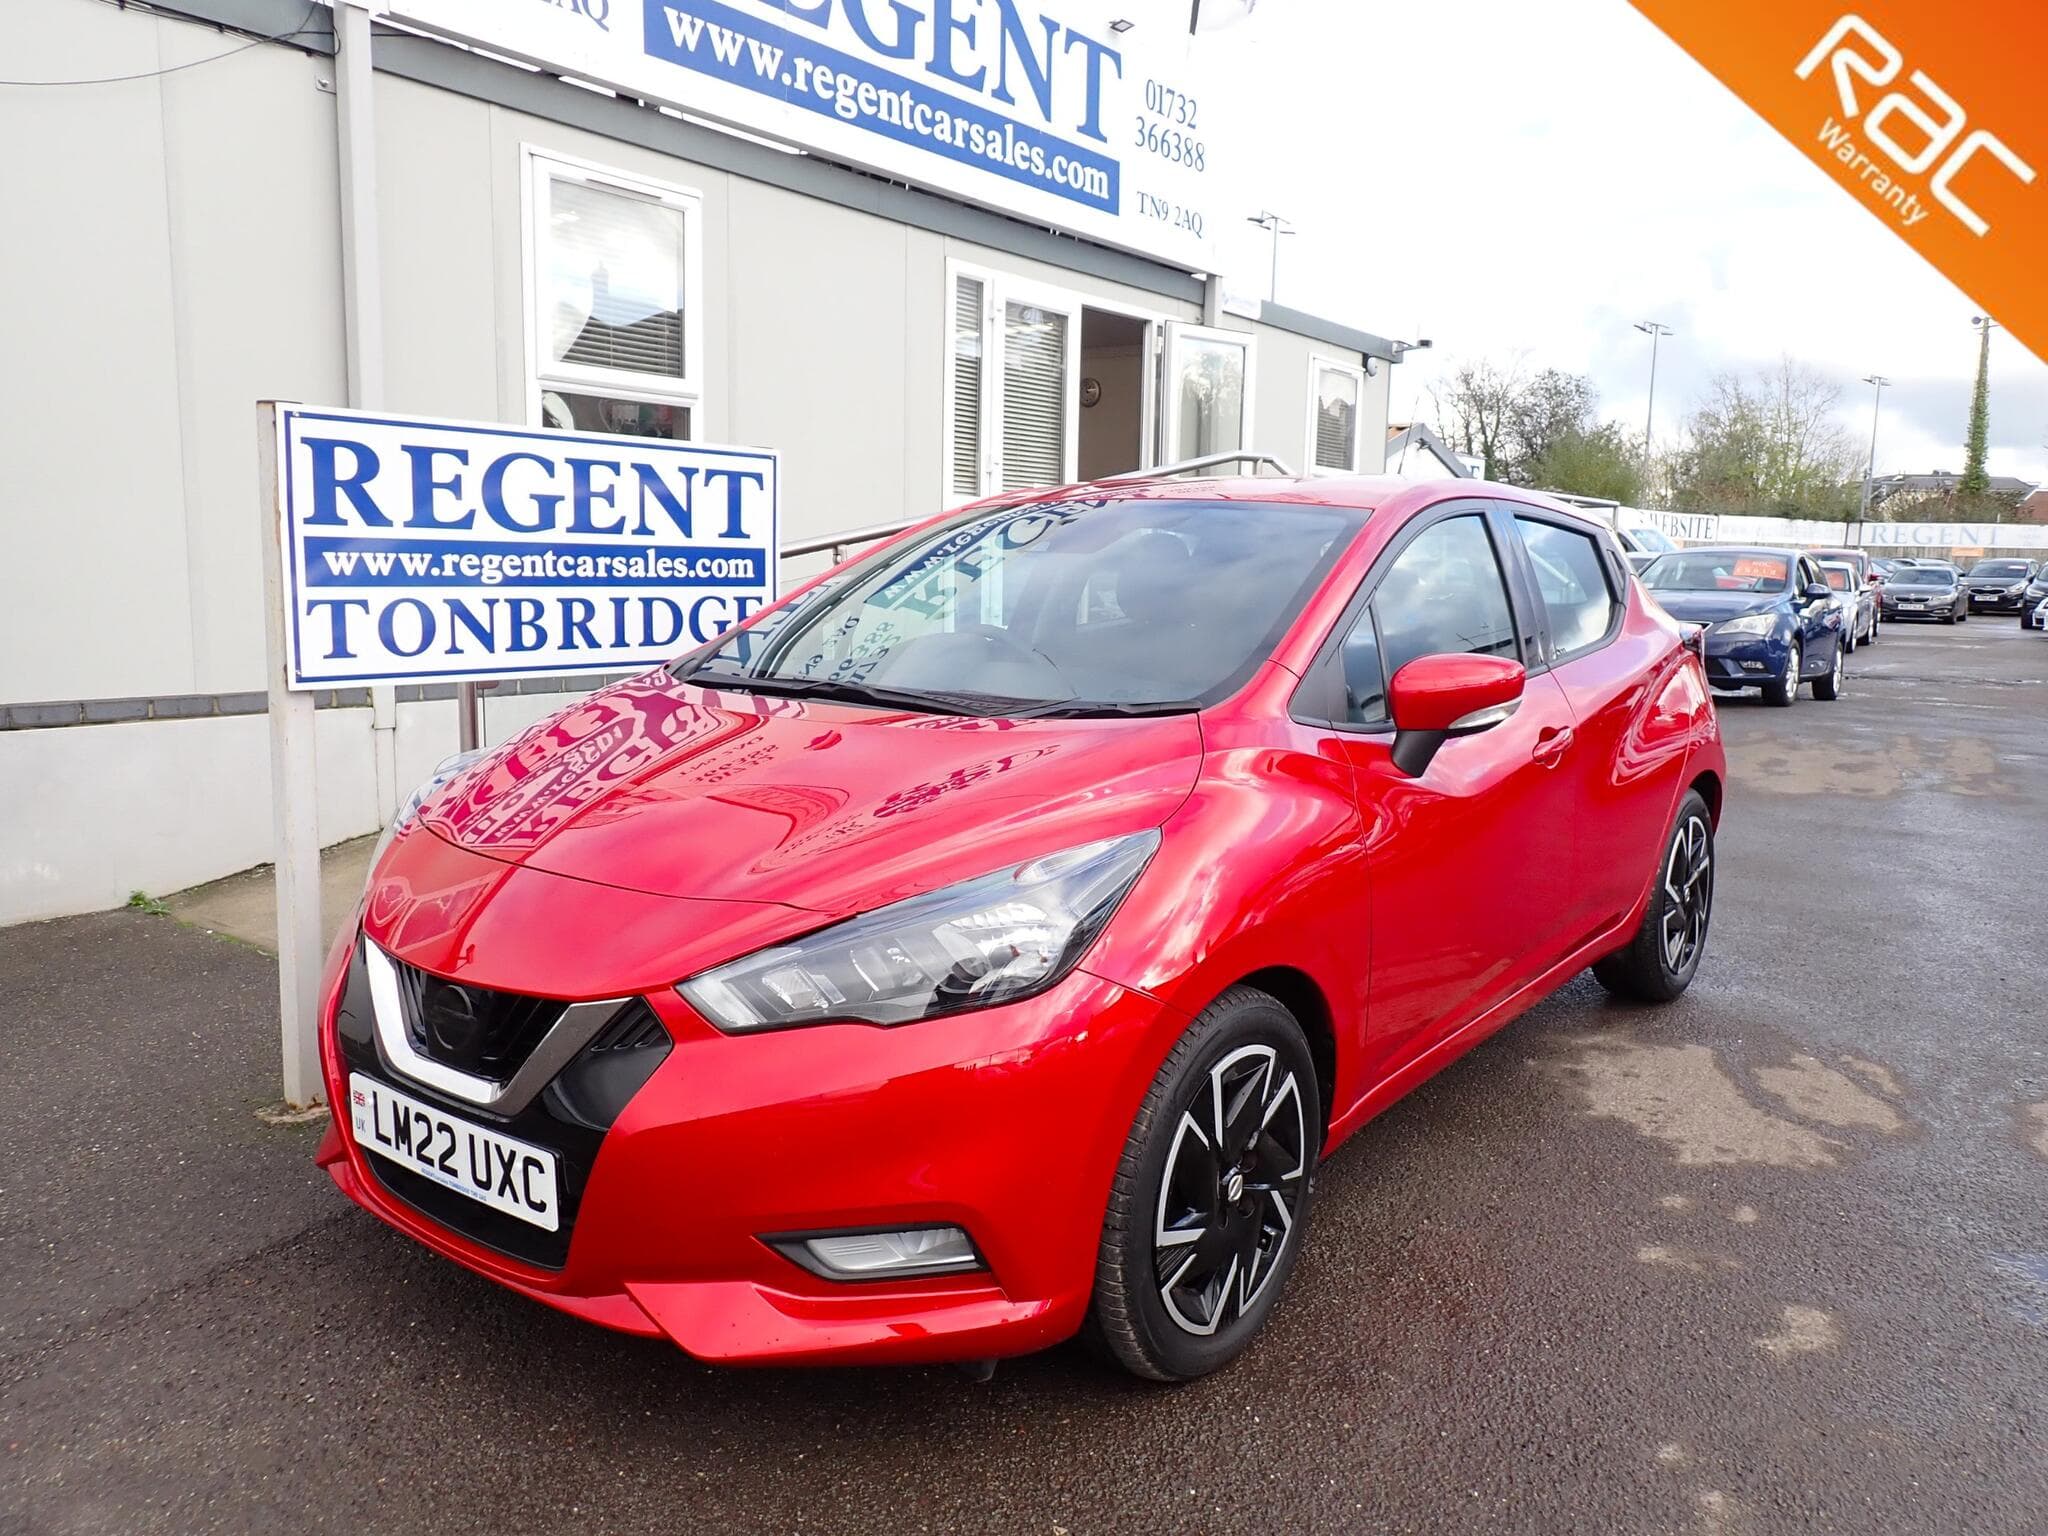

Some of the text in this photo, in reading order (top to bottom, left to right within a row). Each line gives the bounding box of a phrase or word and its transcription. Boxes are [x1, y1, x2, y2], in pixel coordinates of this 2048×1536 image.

[663, 8, 1110, 199] www.regentcarsales.com
[1146, 79, 1197, 129] 01732
[1134, 115, 1205, 172] 366388
[1136, 191, 1203, 239] TN9 2AQ
[301, 437, 764, 539] REGENT
[323, 548, 755, 584] www.regentcarsales.com
[372, 1090, 459, 1179] LM22
[468, 1133, 547, 1214] UXC
